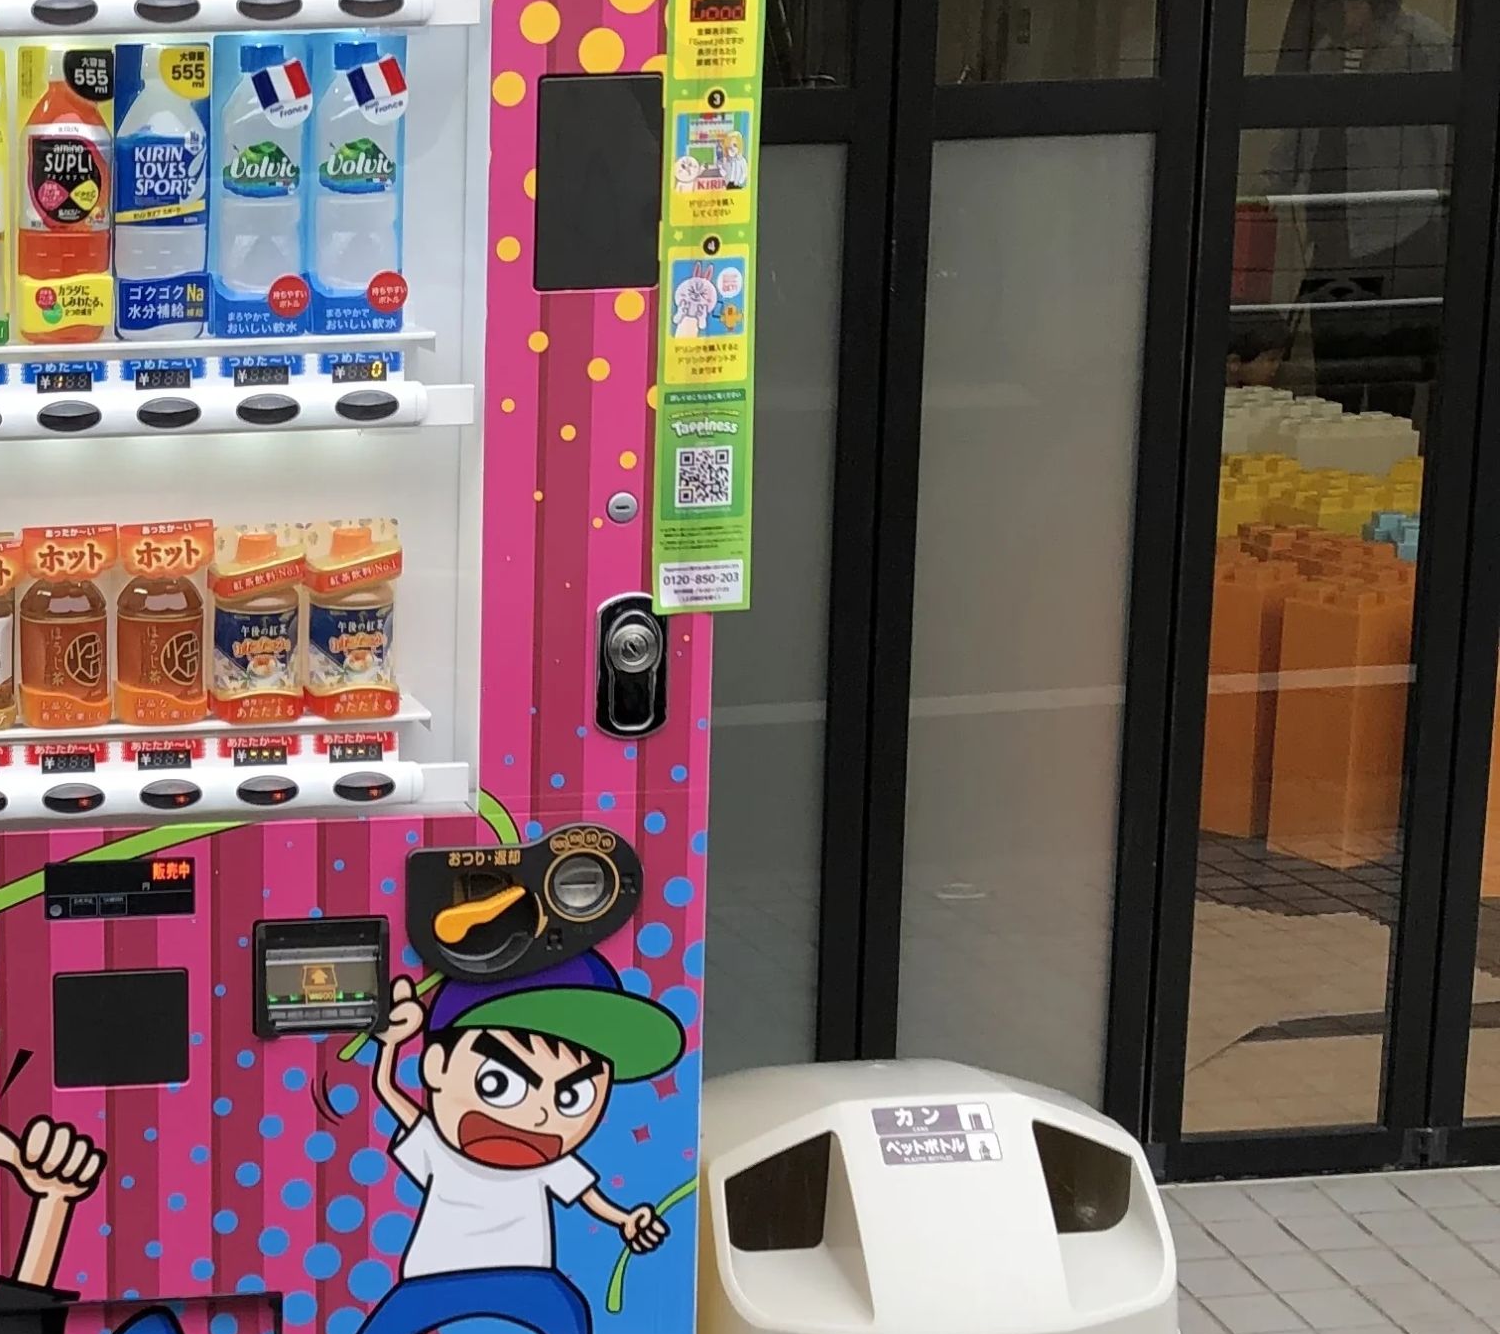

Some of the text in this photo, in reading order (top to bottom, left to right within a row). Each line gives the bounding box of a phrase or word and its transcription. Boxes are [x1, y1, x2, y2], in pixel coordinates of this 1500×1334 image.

[179, 51, 205, 62] 大容量
[74, 68, 108, 94] 555 ml
[171, 64, 205, 89] 555 ml
[713, 93, 721, 105] 3
[279, 103, 309, 119] France
[374, 100, 404, 115] France
[134, 145, 184, 161] KIRIN
[44, 153, 93, 172] SUPLI
[135, 161, 186, 179] LOVES
[230, 157, 296, 180] Volvic
[327, 153, 393, 177] Volvic
[134, 178, 196, 196] SPORTS
[697, 179, 727, 190] KIRIN
[707, 240, 716, 252] 4
[58, 285, 90, 296] カラダに
[128, 285, 184, 302] ゴクゴク
[127, 303, 184, 319] 水分補給
[227, 312, 271, 323] まろやかで
[325, 308, 369, 319] まろやかで
[672, 418, 739, 437] Tappiness
[37, 543, 103, 572] ホット
[135, 539, 200, 568] ホット
[663, 572, 740, 586] 0120-850-203
[240, 625, 287, 636] 午後の紅茶
[337, 621, 384, 632] 午後の紅茶
[237, 706, 295, 717] あたたまる
[334, 702, 393, 712] あたたまる
[448, 850, 521, 866] おつり・返却
[153, 861, 190, 880] 販売中
[895, 1108, 940, 1127] カン
[885, 1138, 966, 1155] ペットボトル
